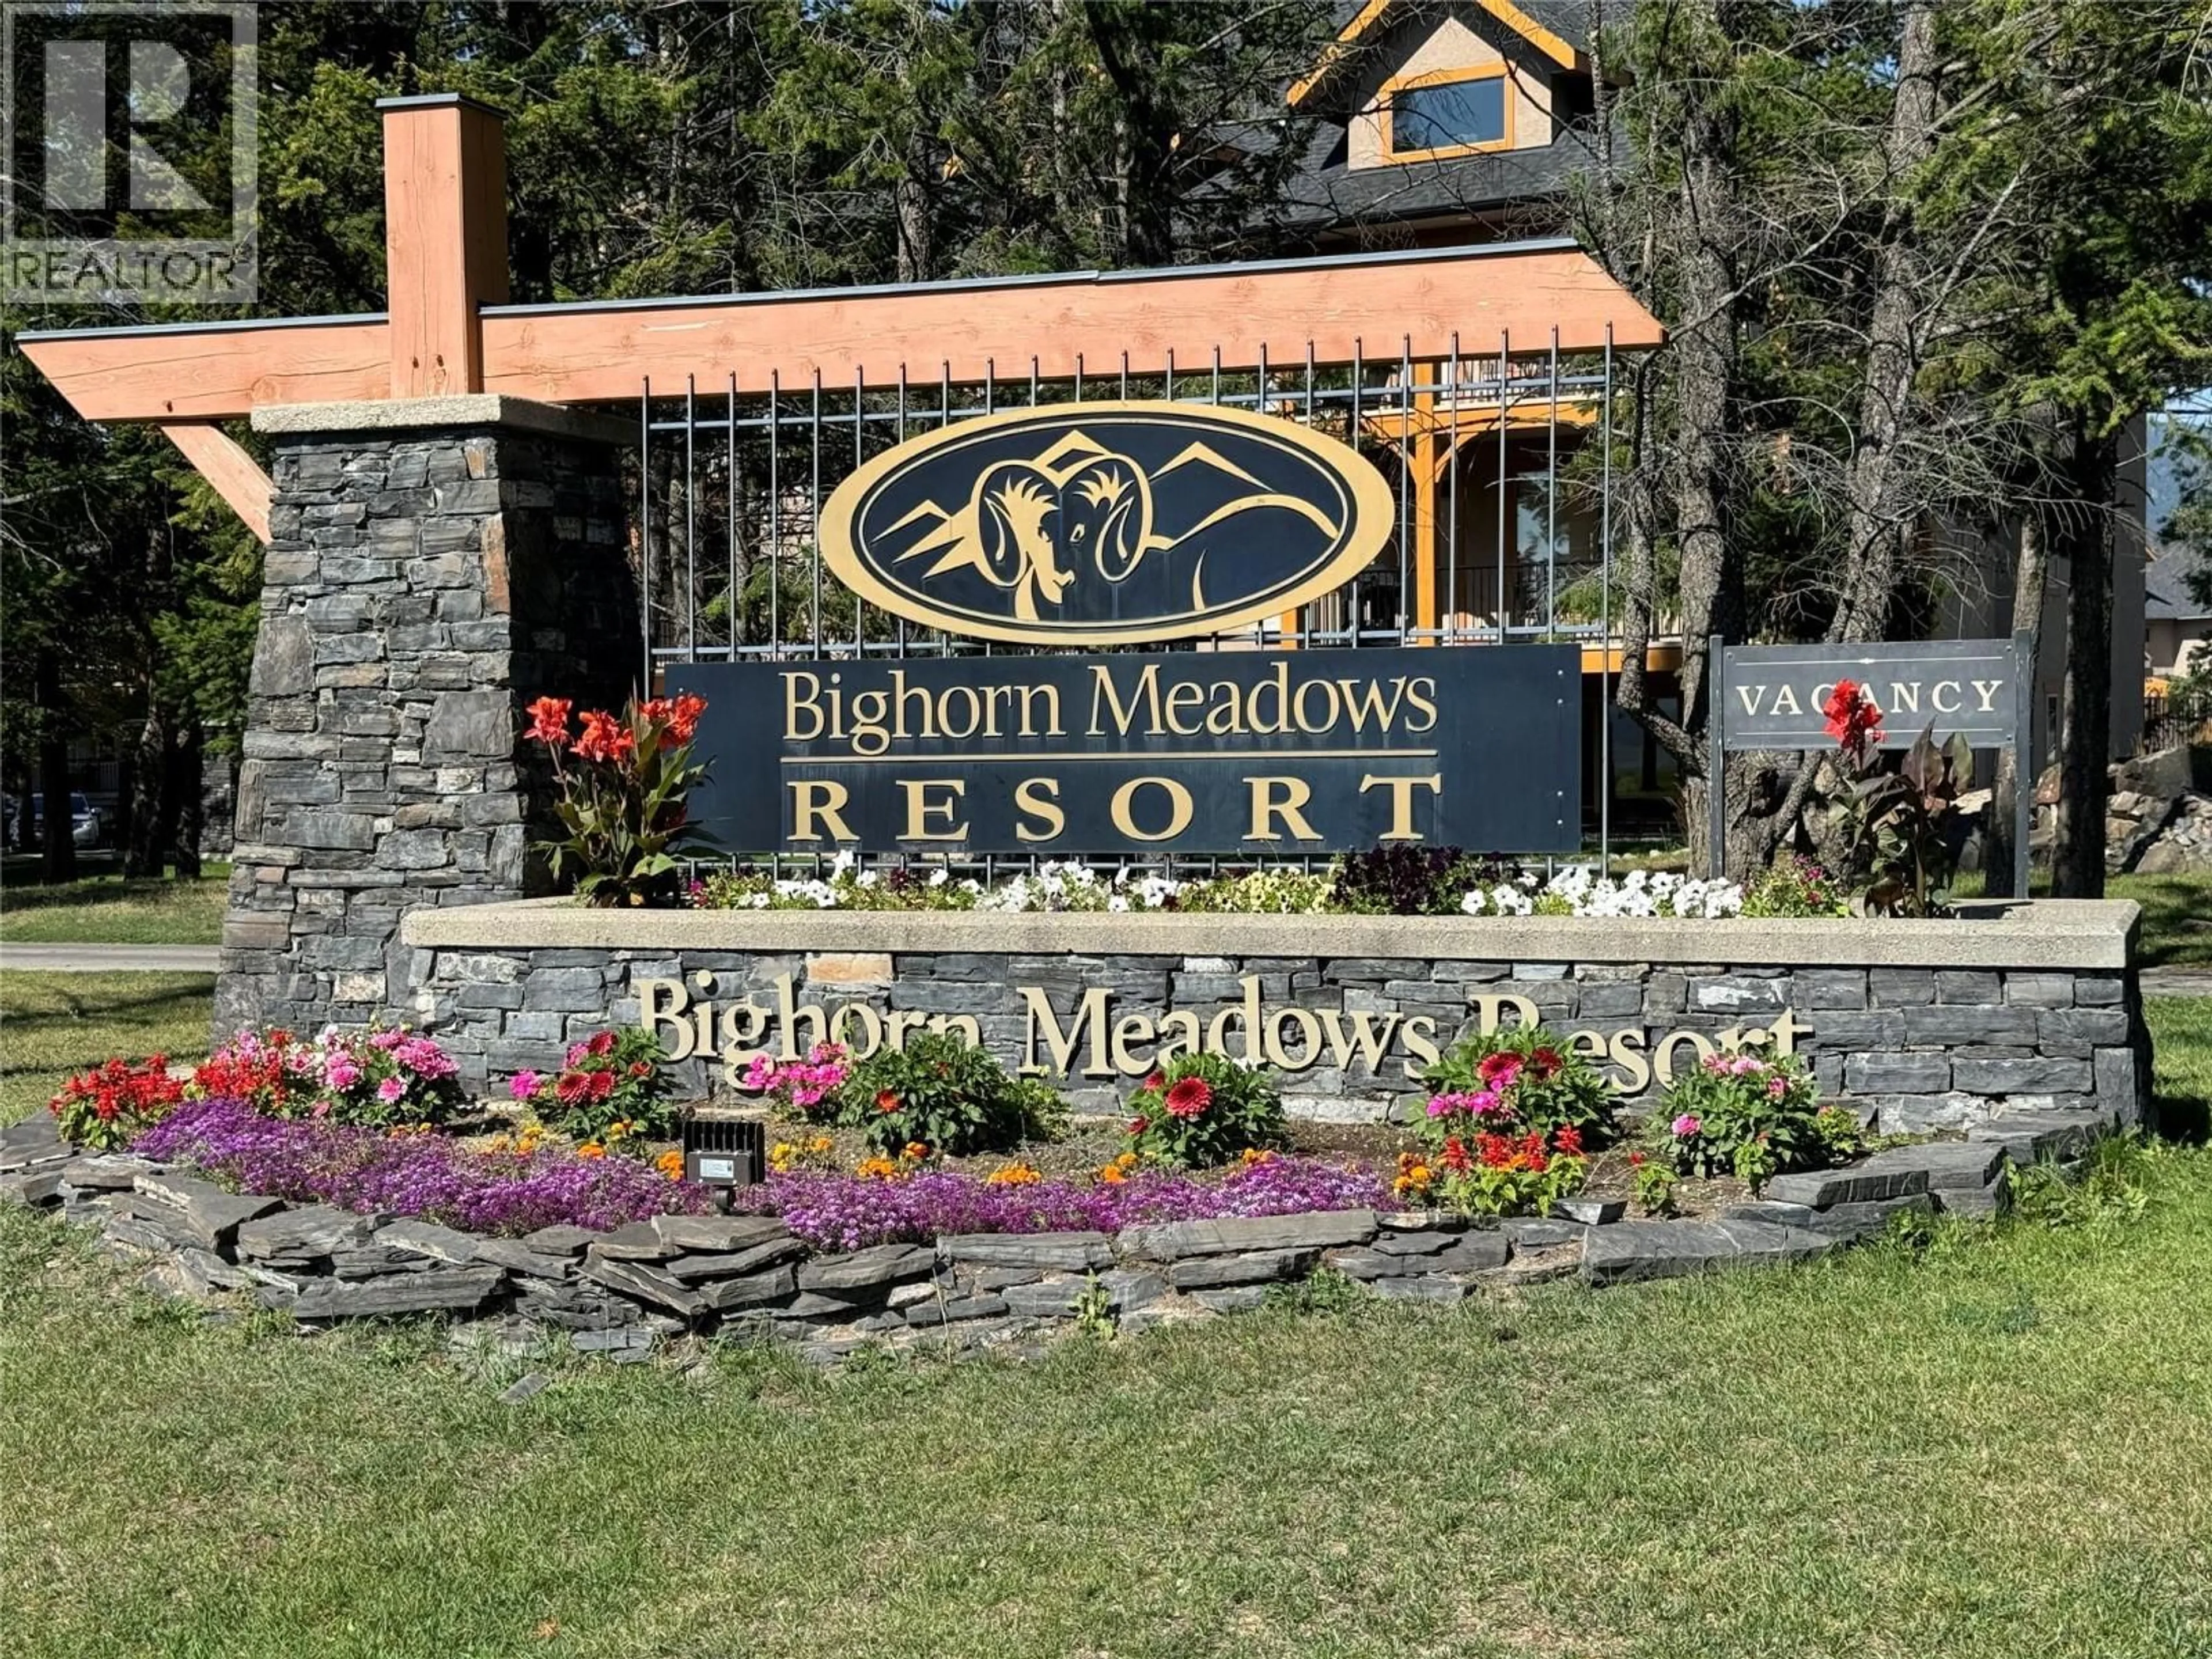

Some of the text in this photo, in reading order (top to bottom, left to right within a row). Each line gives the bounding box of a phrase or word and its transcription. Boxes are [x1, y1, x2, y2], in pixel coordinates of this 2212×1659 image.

[779, 661, 1438, 756] Bighorn Meadows
[1735, 679, 2003, 717] VACANCY
[786, 773, 1442, 842] RESORT
[1016, 974, 1440, 1079] Meadows
